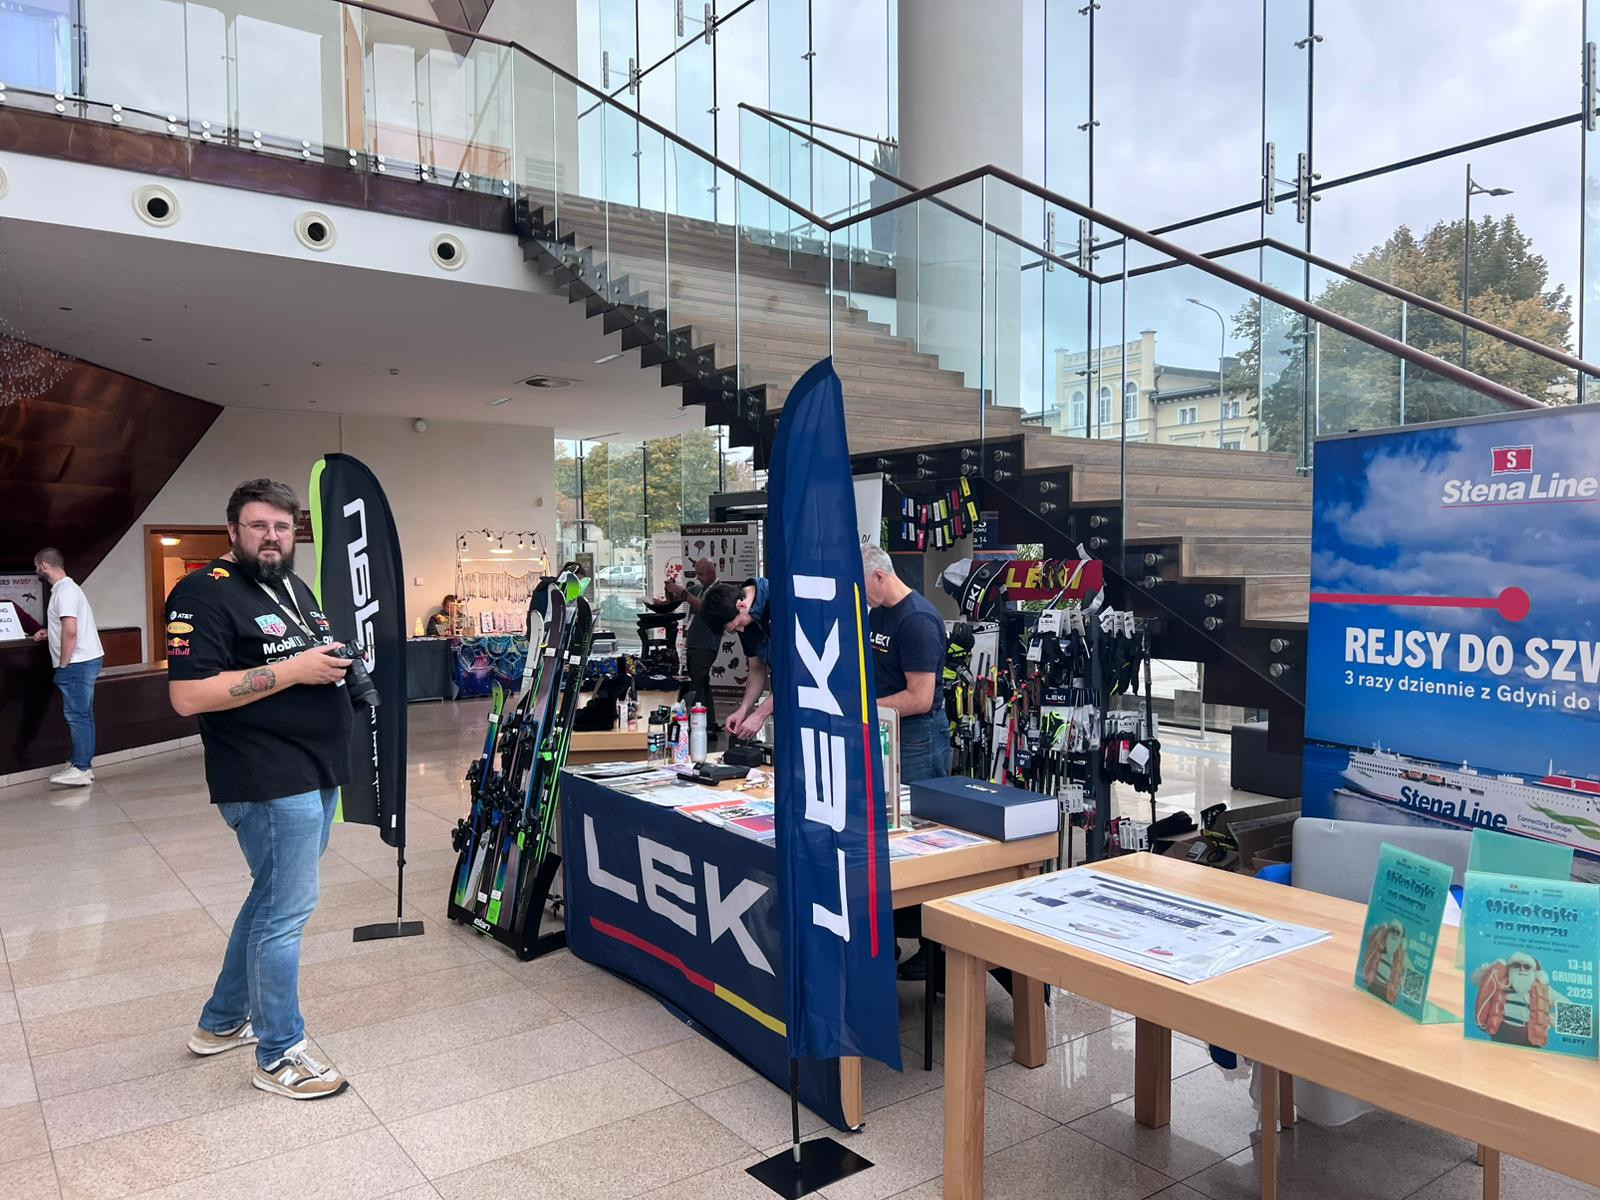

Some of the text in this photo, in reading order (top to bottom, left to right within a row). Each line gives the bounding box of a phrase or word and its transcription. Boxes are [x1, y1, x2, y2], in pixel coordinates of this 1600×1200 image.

[1507, 450, 1518, 469] S
[1441, 472, 1599, 503] Stena Line
[176, 612, 194, 620] AT&T
[869, 631, 891, 647] LEKI
[1344, 627, 1450, 670] REJSY
[1459, 633, 1514, 676] DO
[1344, 671, 1591, 711] 3 razy dziennie z Gdyni do
[792, 574, 851, 943] LEKI
[1400, 785, 1508, 830] Stena Line
[583, 813, 777, 977] LEK
[473, 917, 491, 931] elan
[1567, 959, 1593, 972] 13-14
[1566, 985, 1593, 1000] 2025
